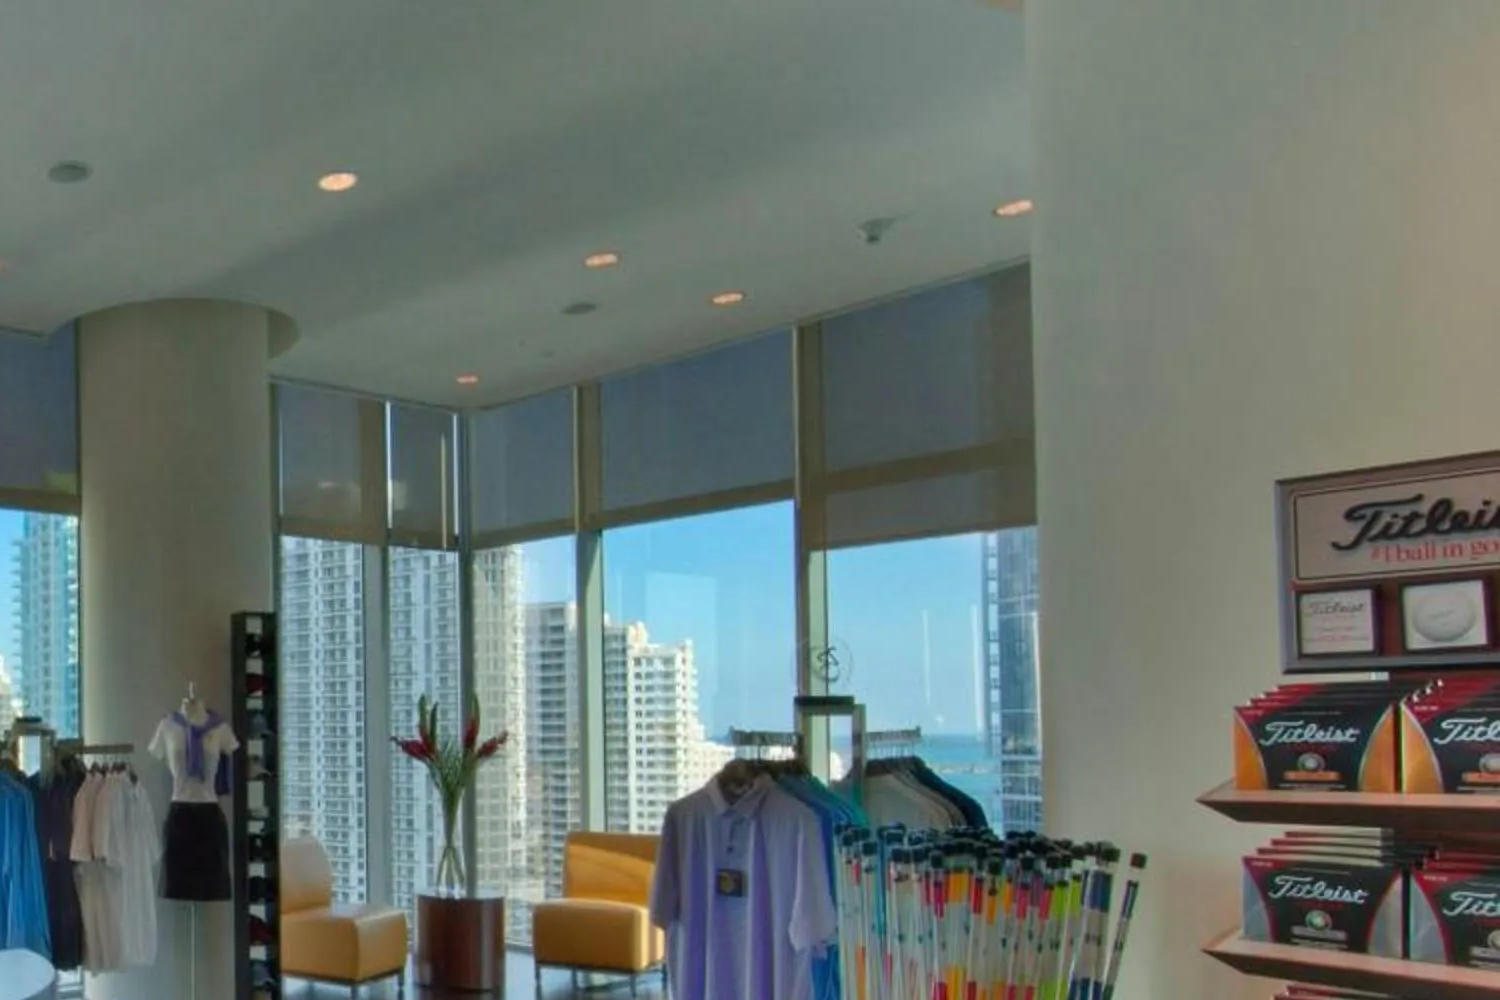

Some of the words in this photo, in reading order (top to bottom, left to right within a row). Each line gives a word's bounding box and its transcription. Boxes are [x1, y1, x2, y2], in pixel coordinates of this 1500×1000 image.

[1330, 493, 1500, 551] Titlei
[1397, 542, 1437, 562] ball
[1442, 543, 1464, 558] in
[1471, 539, 1500, 561] go
[1259, 719, 1361, 747] Titleist
[1433, 717, 1500, 745] Titl
[1268, 874, 1369, 905] Titleist
